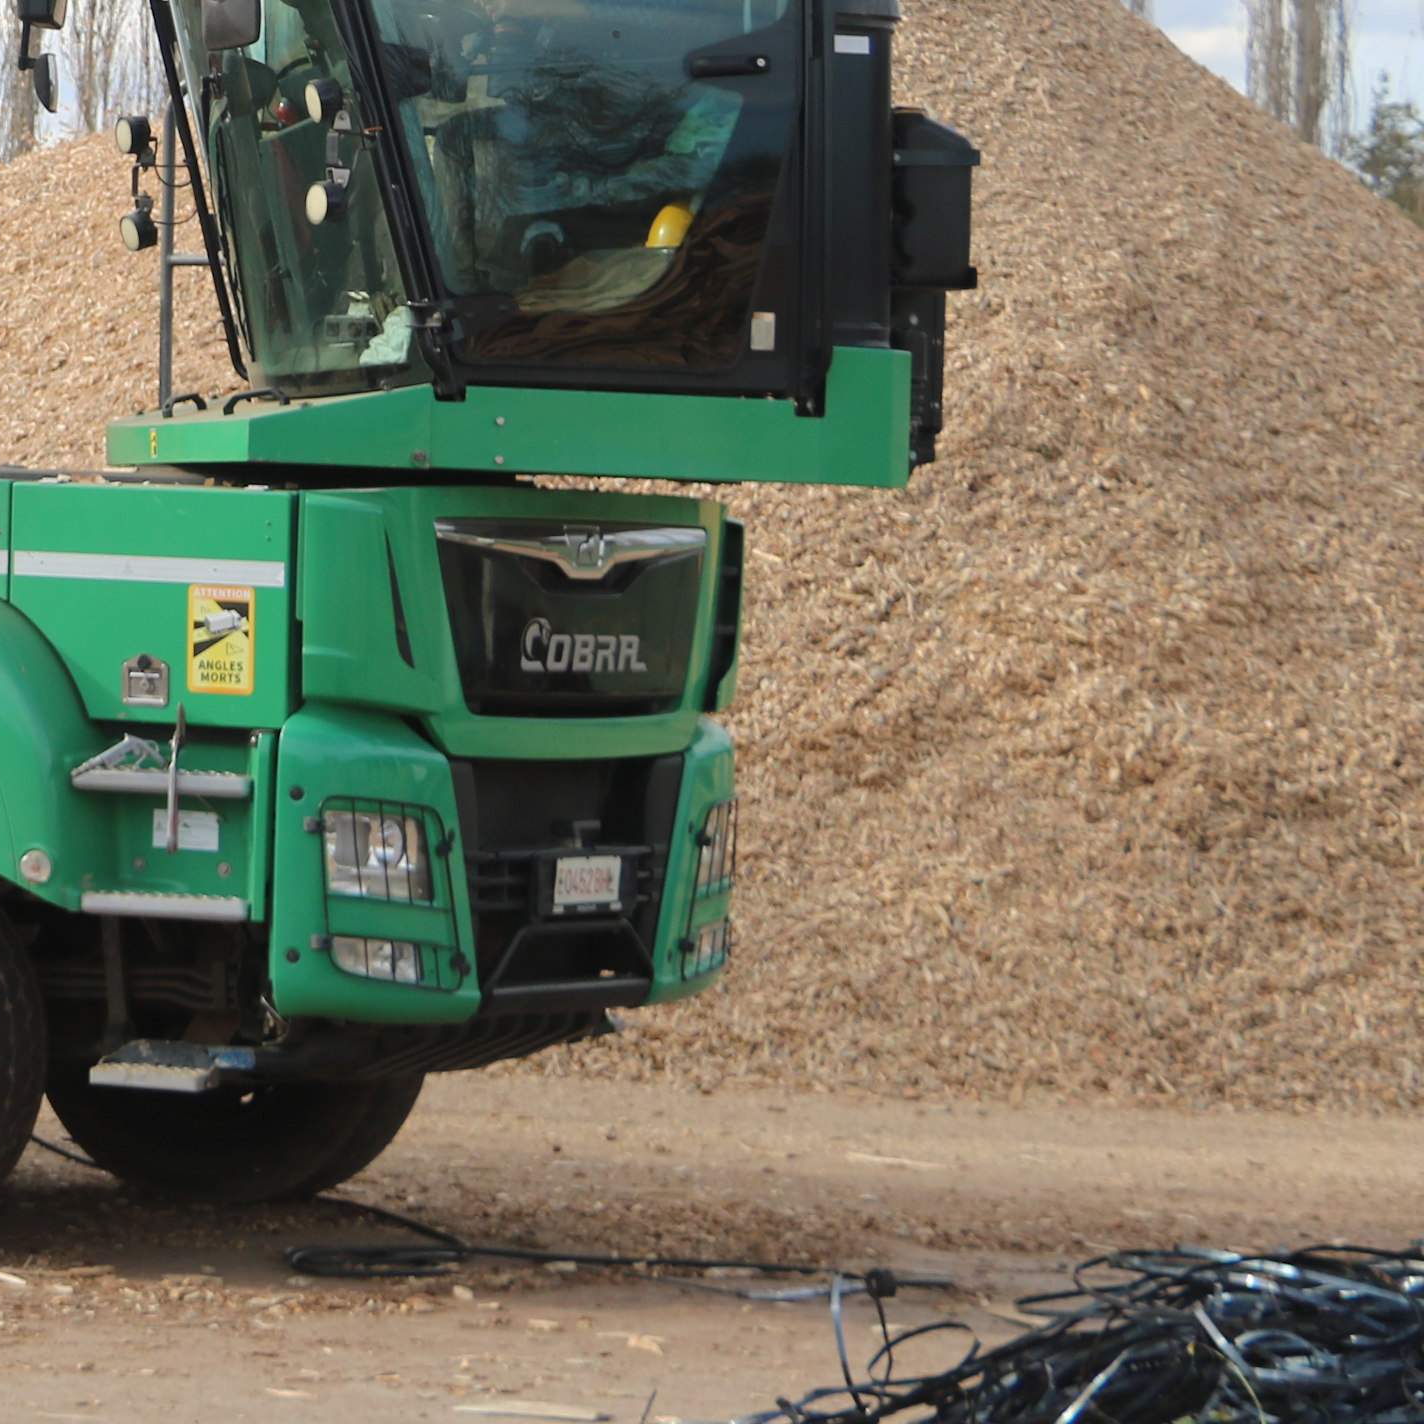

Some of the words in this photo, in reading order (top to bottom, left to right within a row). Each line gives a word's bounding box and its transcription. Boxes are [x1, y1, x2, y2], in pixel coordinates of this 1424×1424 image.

[194, 588, 250, 599] ATTENTION
[520, 617, 649, 673] COBRA
[198, 660, 244, 672] ANGLES
[200, 672, 242, 683] MORTS
